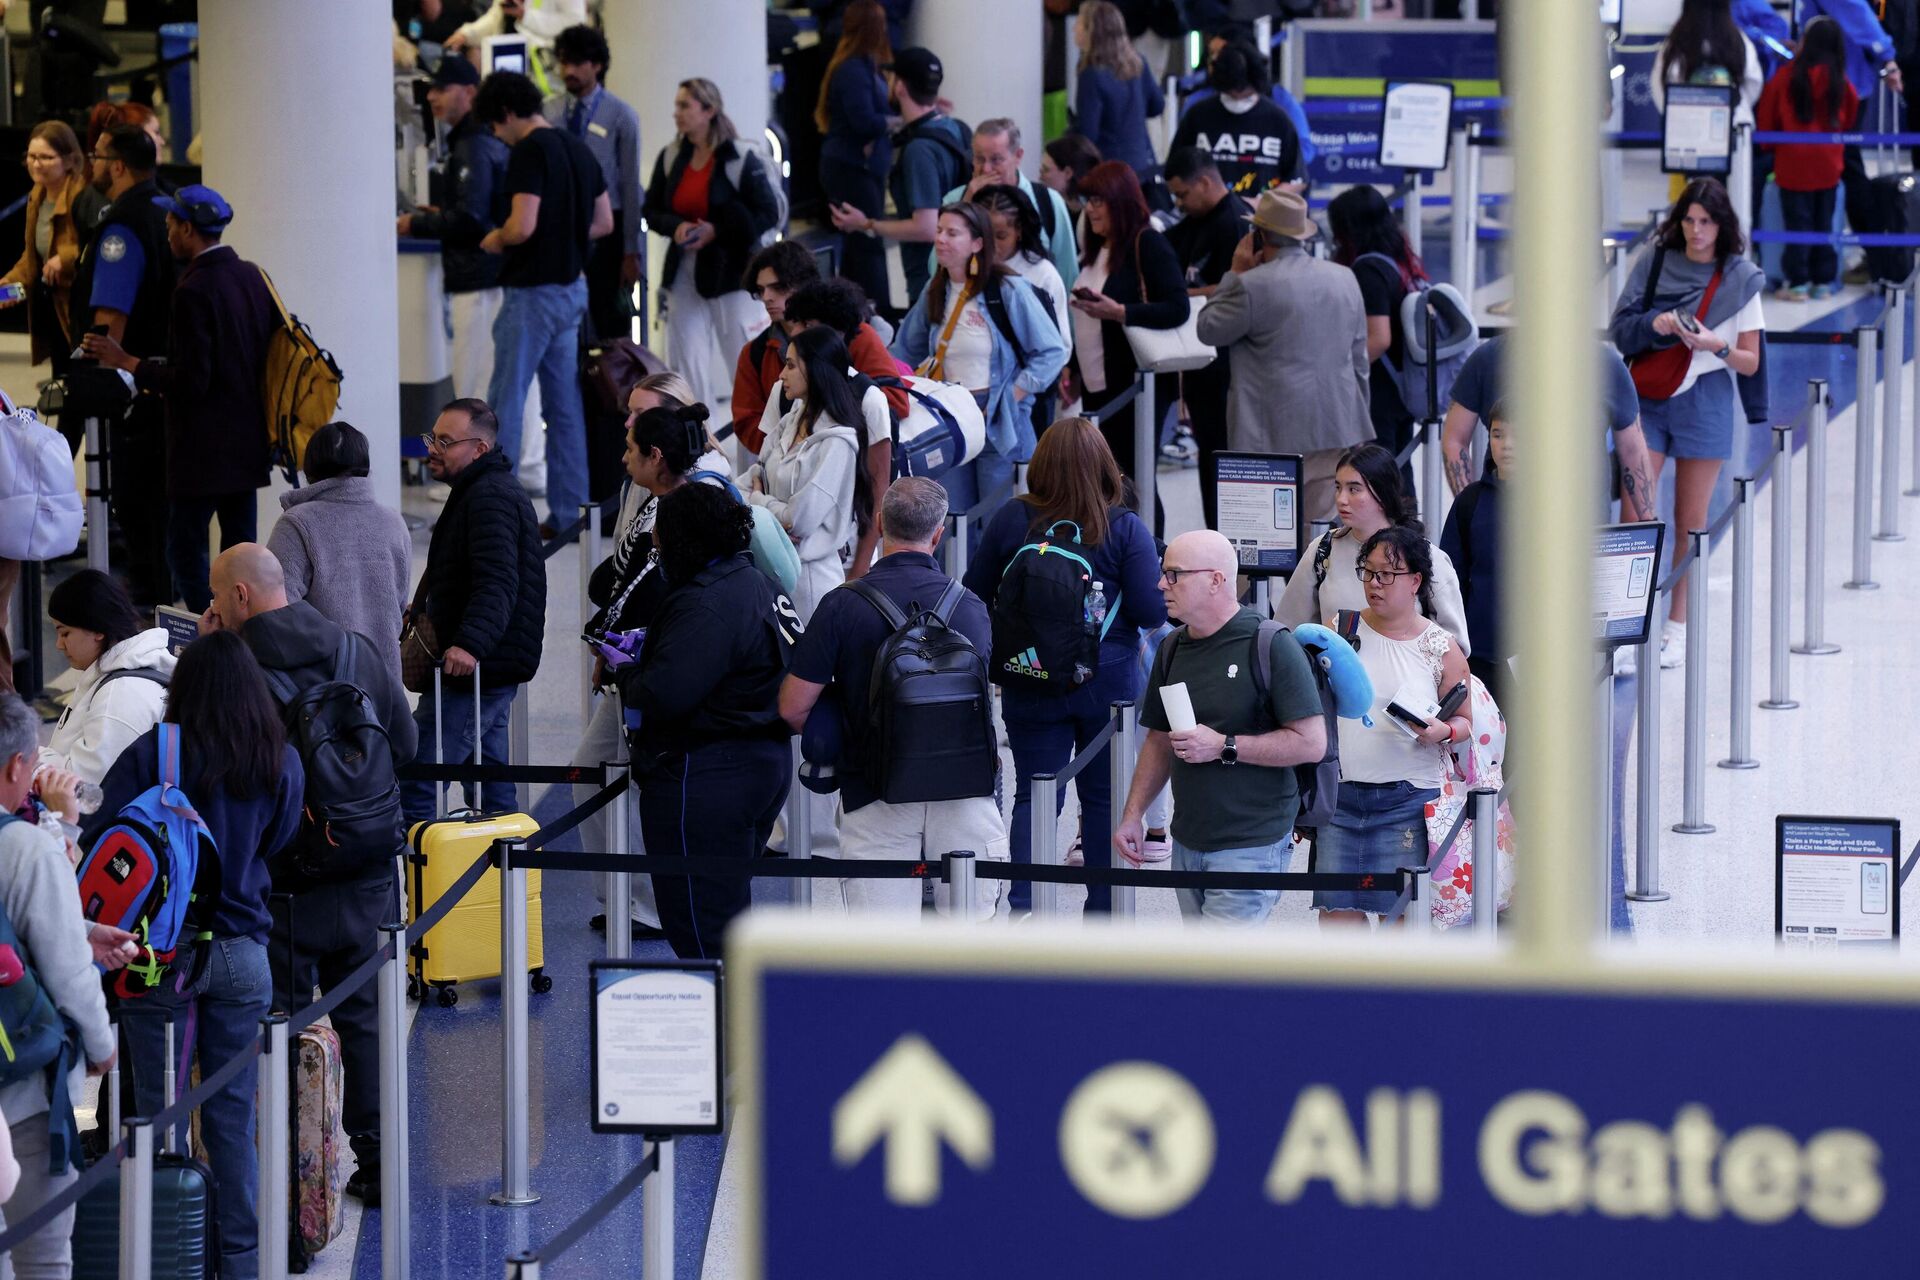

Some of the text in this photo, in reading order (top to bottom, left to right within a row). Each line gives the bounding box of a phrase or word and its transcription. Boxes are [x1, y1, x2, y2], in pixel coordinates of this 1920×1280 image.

[1196, 132, 1281, 157] AAPE
[1004, 662, 1048, 680] adidas
[633, 993, 677, 1001] Opportunity
[1264, 1084, 1885, 1228] All Gates
